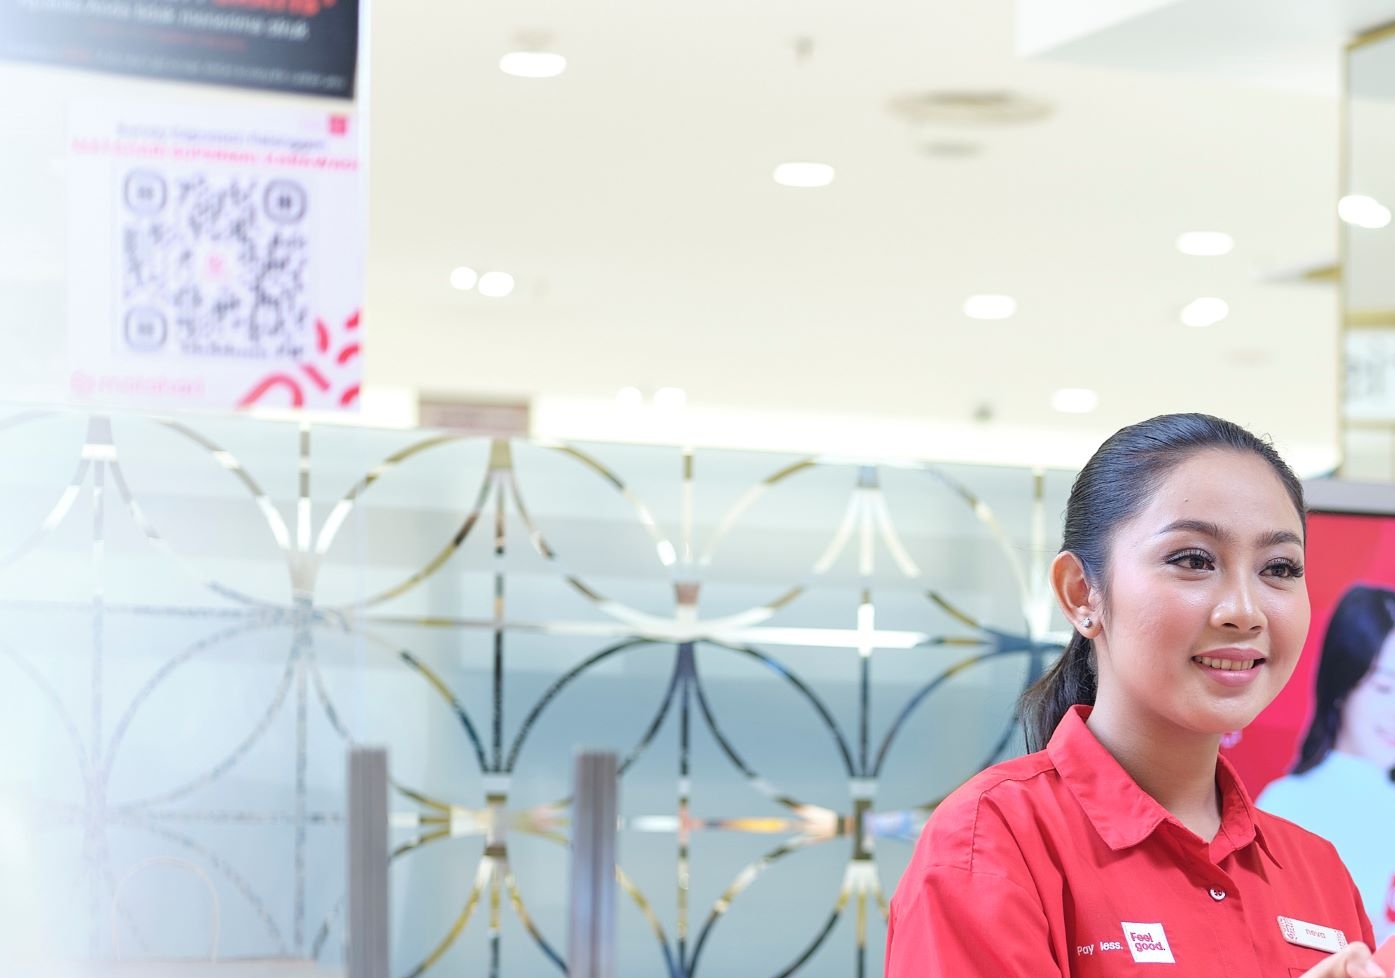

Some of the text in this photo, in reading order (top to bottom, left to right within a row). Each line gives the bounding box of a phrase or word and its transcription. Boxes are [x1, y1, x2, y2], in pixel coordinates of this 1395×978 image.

[1077, 931, 1154, 956] Pay less. Feel
[1135, 942, 1166, 952] good.
